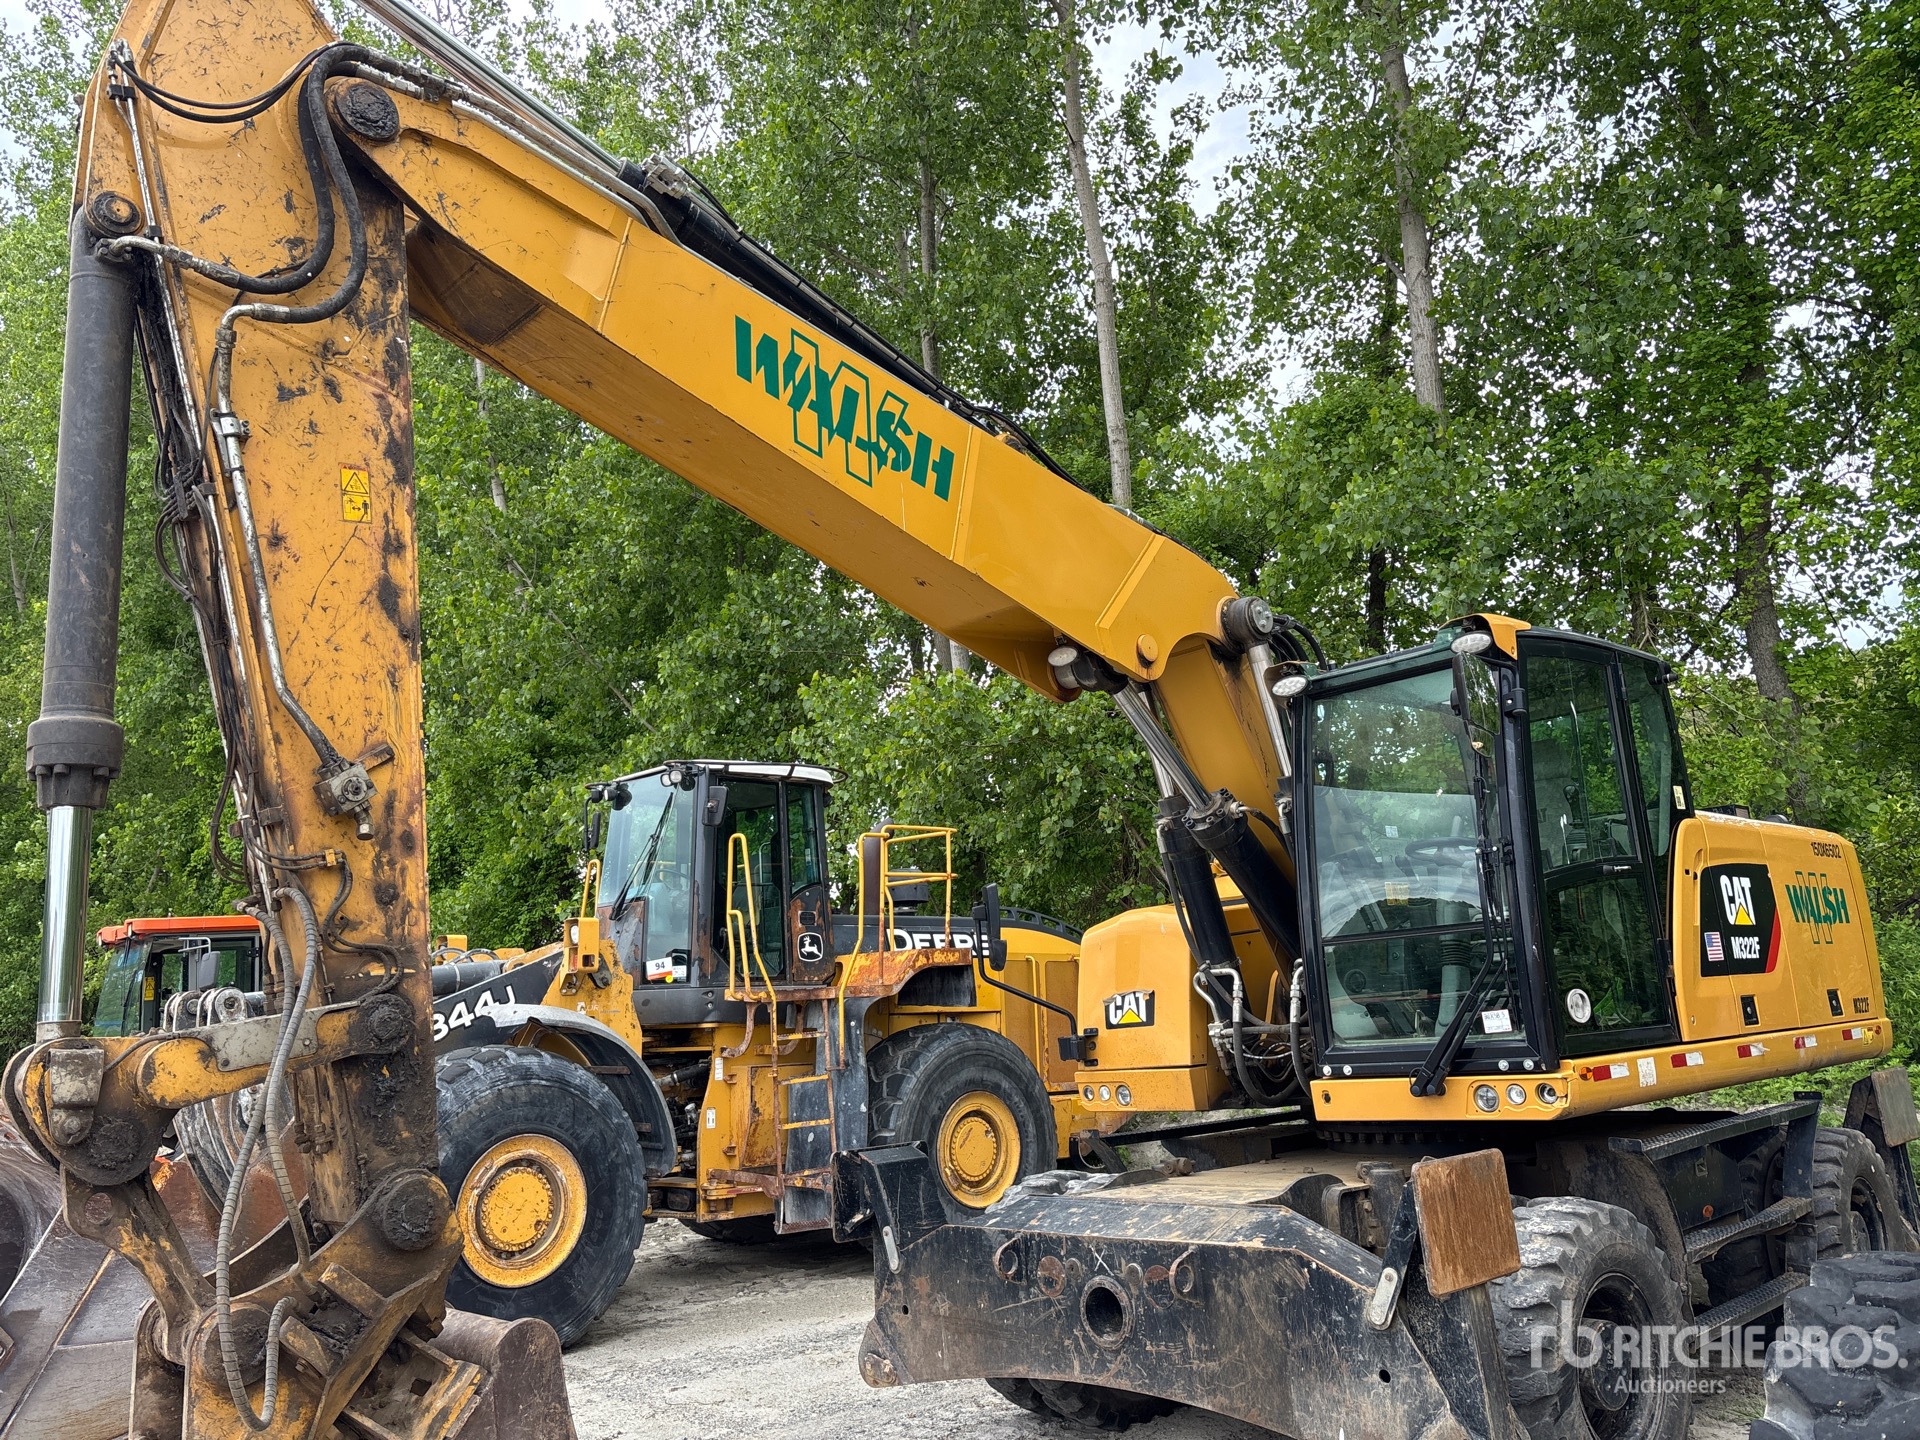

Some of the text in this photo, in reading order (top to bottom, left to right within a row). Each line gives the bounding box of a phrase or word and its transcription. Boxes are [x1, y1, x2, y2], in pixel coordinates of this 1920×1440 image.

[735, 314, 955, 502] WALSH
[1719, 874, 1756, 926] CAT
[1784, 884, 1850, 924] WALSH
[1730, 936, 1760, 960] M322F
[655, 961, 666, 971] 94
[1108, 991, 1149, 1025] CAT
[1853, 997, 1870, 1014] M322F
